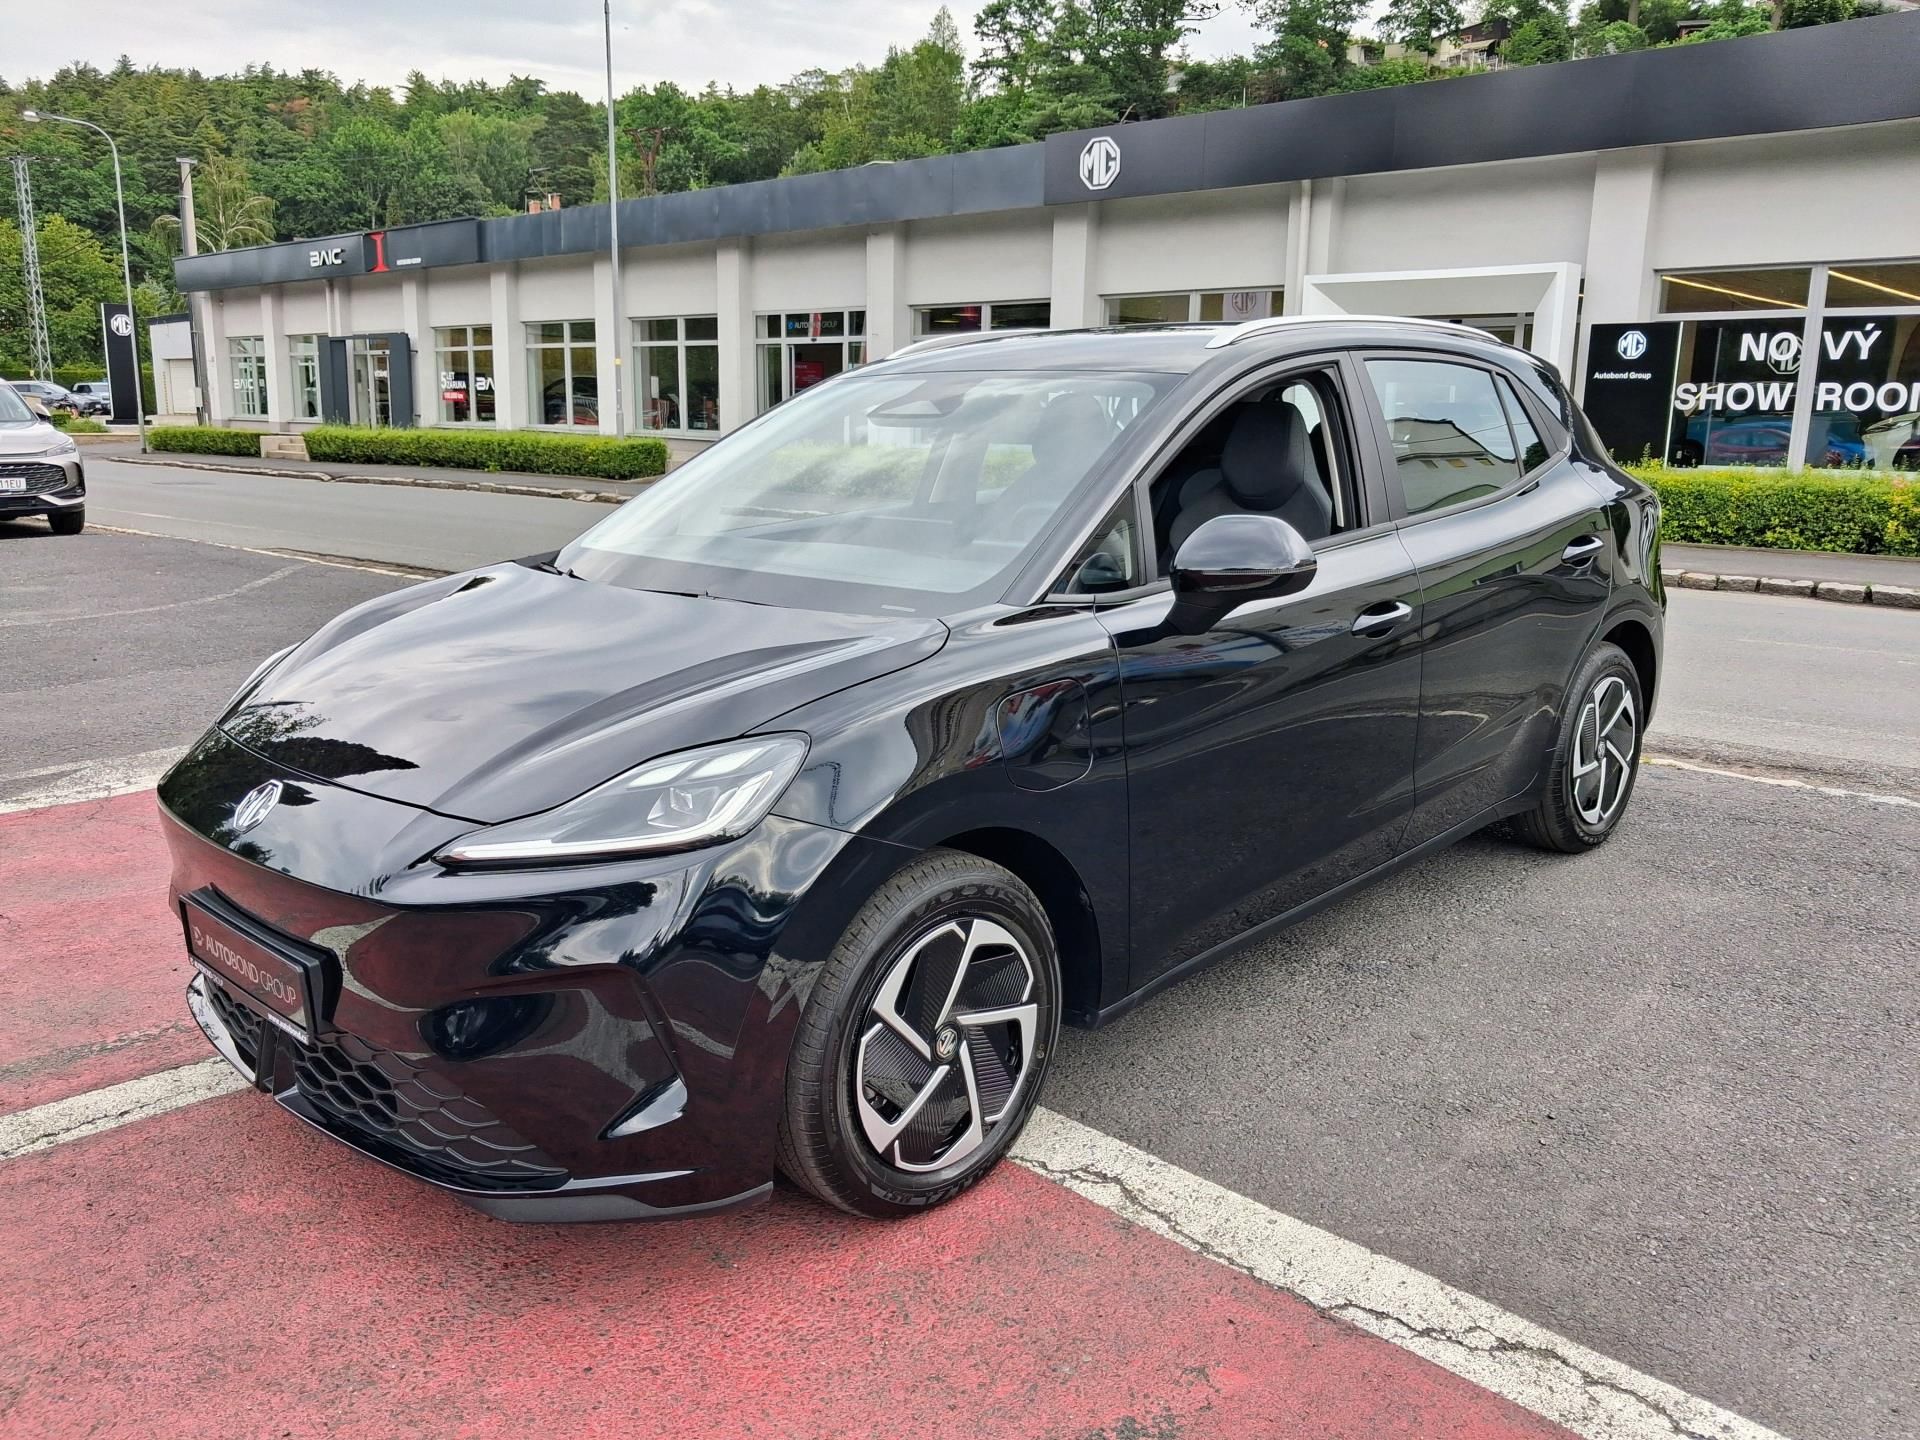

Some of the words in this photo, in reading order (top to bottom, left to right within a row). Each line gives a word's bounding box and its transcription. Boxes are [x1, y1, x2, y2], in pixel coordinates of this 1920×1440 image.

[1083, 141, 1117, 186] MG
[309, 248, 342, 267] BAIC
[1620, 332, 1644, 357] MG
[440, 371, 447, 389] 5
[1592, 371, 1629, 380] Autobond
[1629, 371, 1652, 381] Group
[236, 783, 280, 829] MG
[206, 934, 259, 983] AUTOBOND
[260, 969, 297, 1006] GROUP
